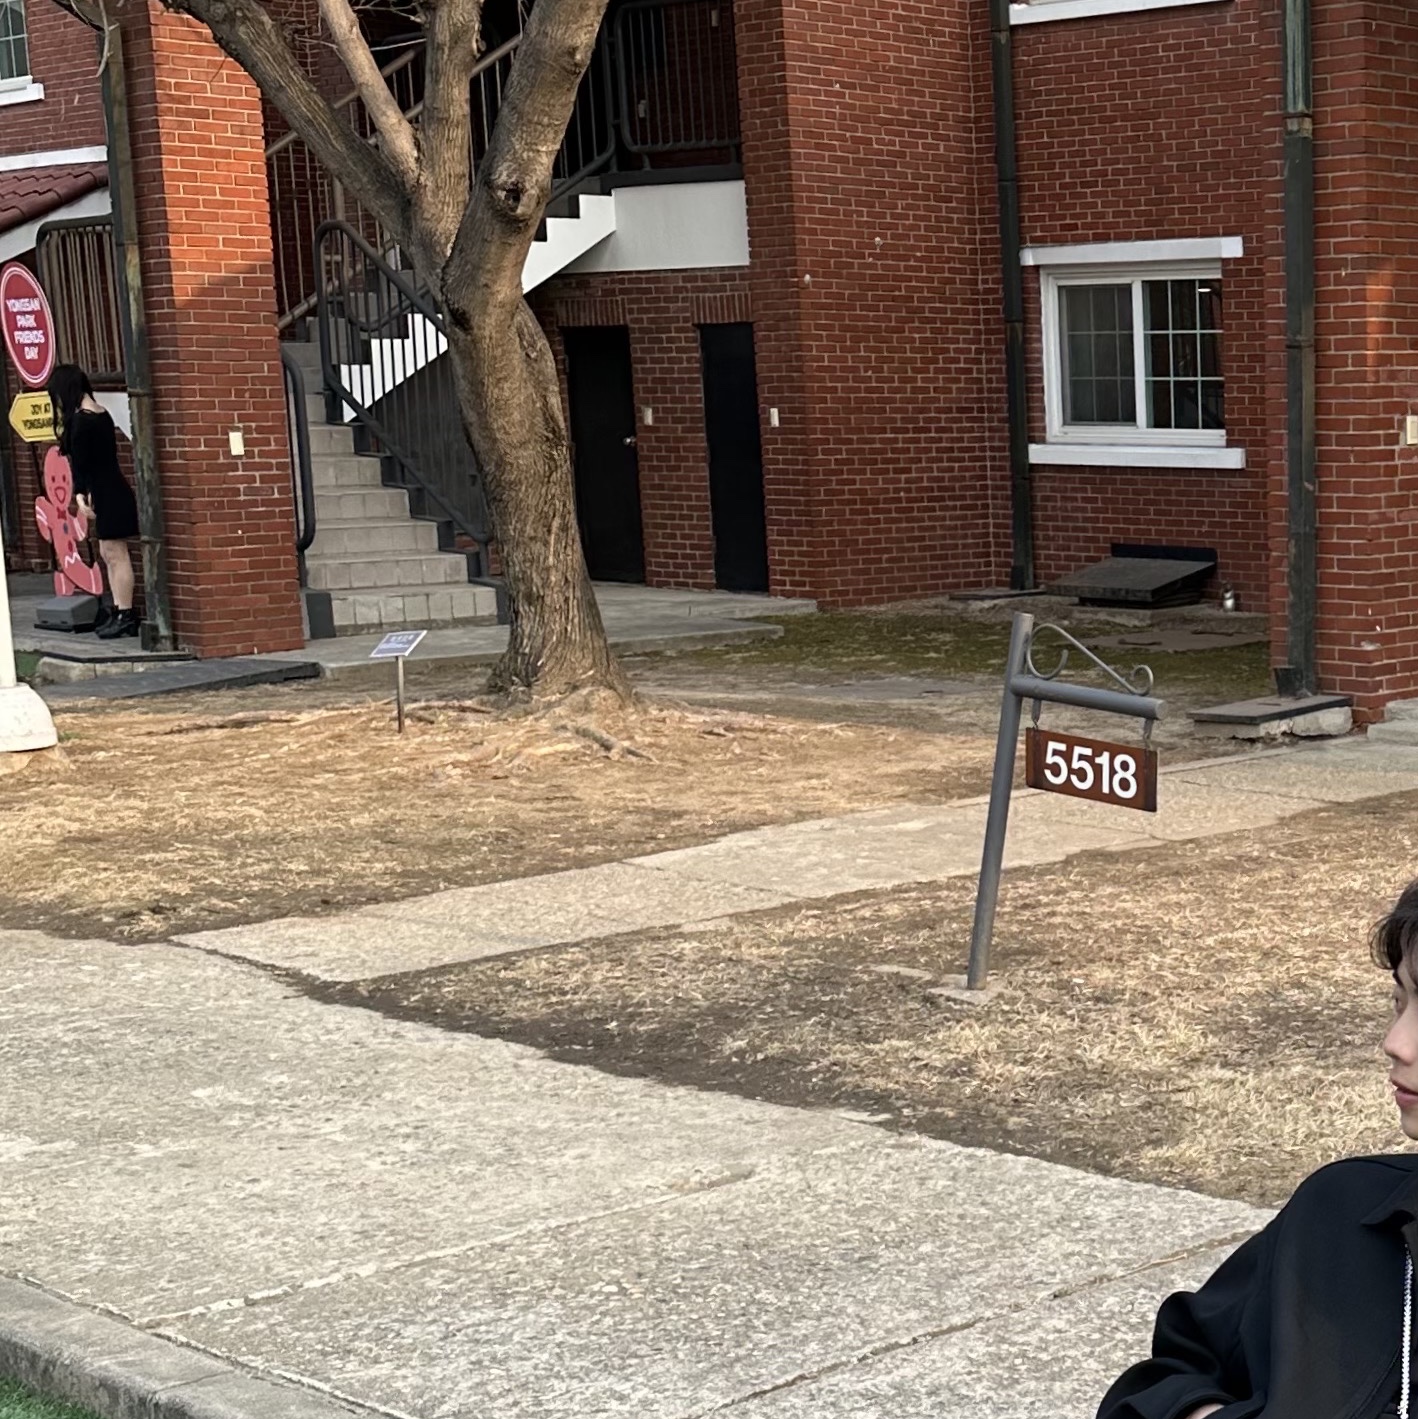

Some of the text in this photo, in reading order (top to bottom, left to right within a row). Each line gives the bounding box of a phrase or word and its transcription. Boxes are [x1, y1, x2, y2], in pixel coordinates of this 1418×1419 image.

[6, 298, 41, 312] YONGSAN
[16, 314, 37, 328] PARK
[13, 330, 45, 344] FRIENDS
[24, 346, 39, 360] DAY
[1044, 741, 1138, 799] 5518
